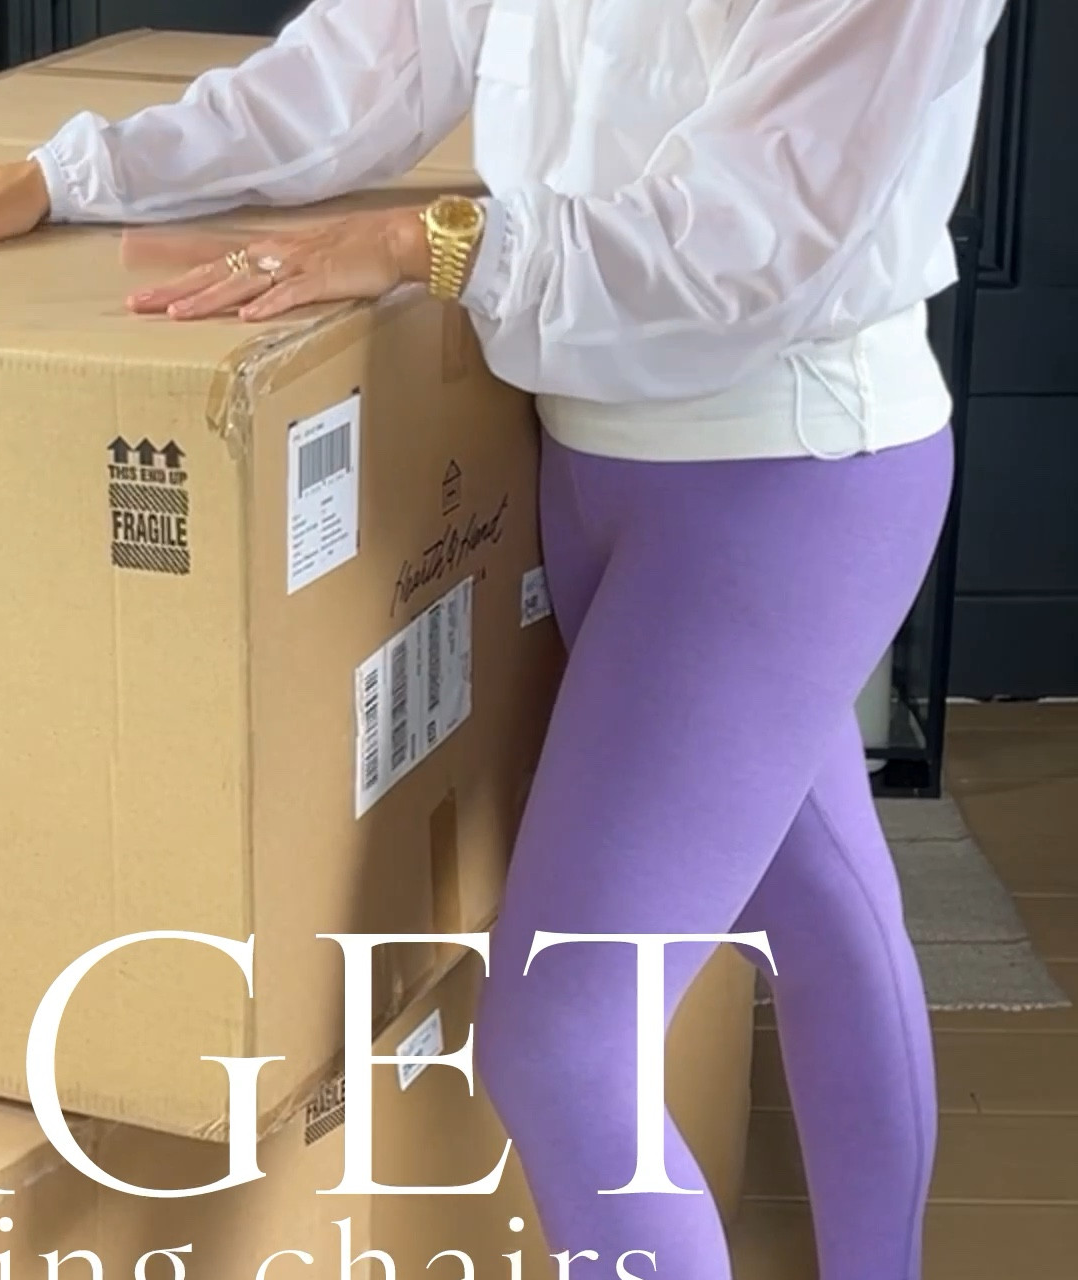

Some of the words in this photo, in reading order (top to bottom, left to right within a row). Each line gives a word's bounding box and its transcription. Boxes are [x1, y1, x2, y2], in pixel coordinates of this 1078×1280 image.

[107, 464, 138, 481] THIS
[140, 467, 166, 484] END
[168, 470, 188, 486] UP
[111, 509, 187, 547] FRAGILE
